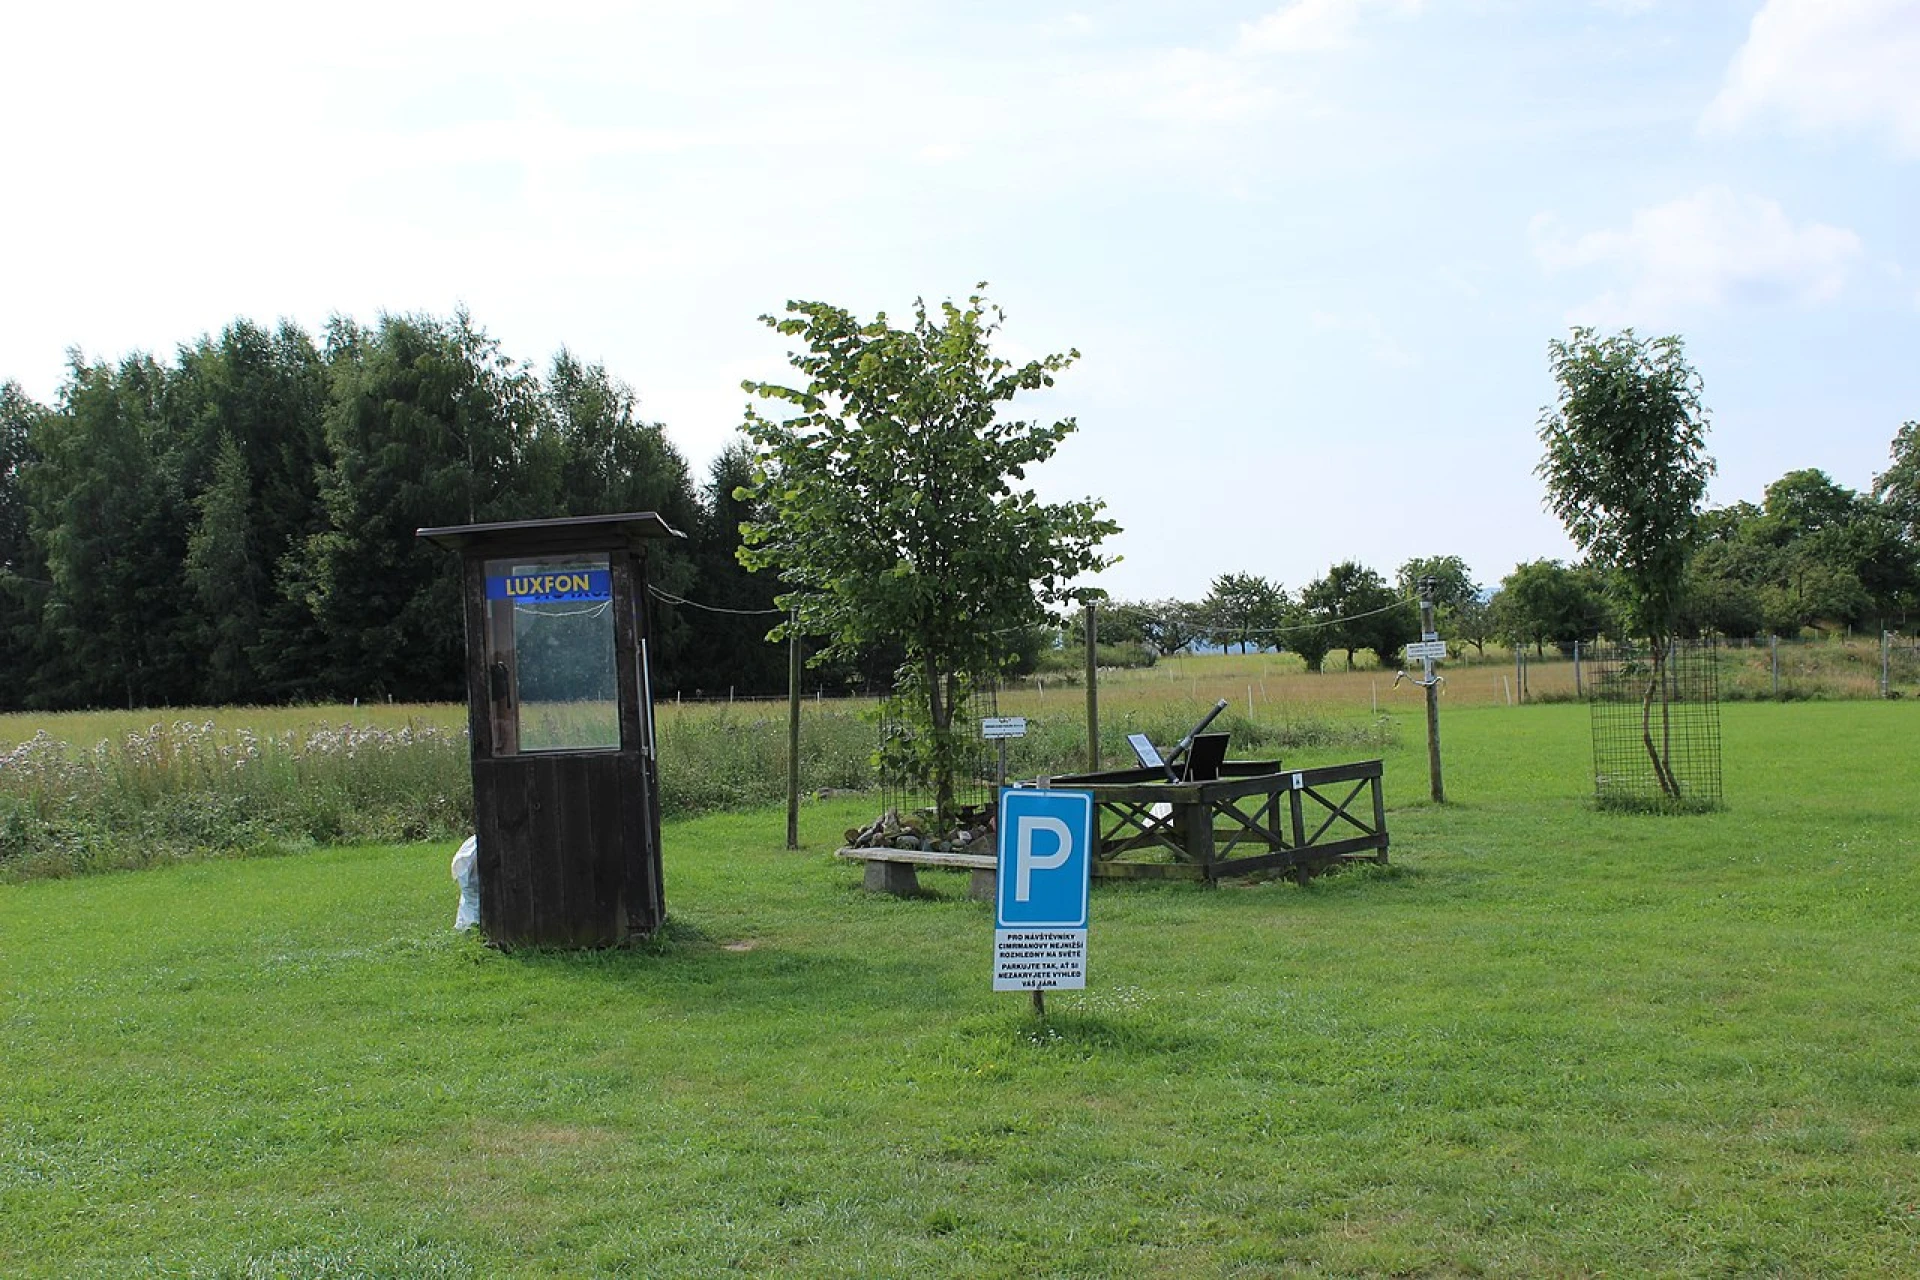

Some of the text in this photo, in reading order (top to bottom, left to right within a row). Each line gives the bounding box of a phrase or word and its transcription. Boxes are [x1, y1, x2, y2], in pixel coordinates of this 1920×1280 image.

[506, 575, 589, 596] LUXFON
[1015, 816, 1072, 901] P
[1025, 932, 1075, 940] NÁVŠTĚVNÍKY
[1050, 941, 1084, 949] NEJNIŽŠÍ
[1001, 962, 1040, 970] PARKUJTE
[1042, 962, 1058, 970] TAK,
[1060, 961, 1069, 969] AŤ
